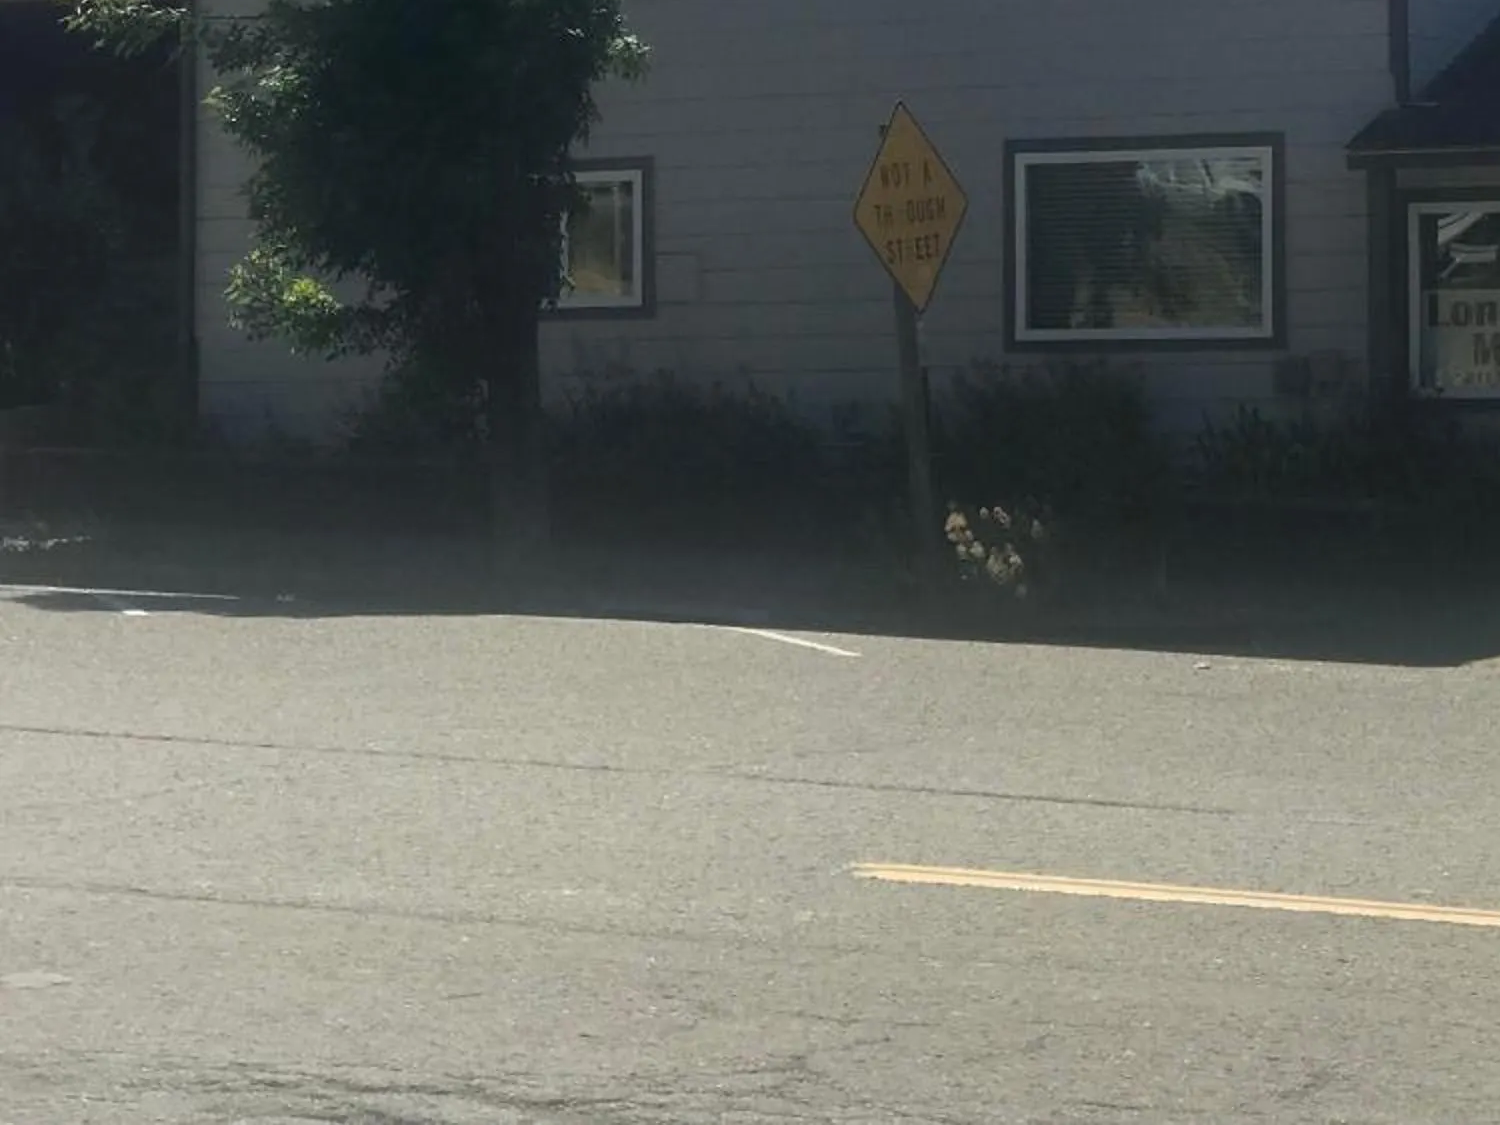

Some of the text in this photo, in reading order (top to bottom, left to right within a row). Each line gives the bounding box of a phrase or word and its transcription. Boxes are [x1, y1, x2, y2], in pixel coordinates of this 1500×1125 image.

[879, 157, 933, 188] NOT A
[873, 194, 946, 227] THOUGH
[885, 232, 941, 268] STEET
